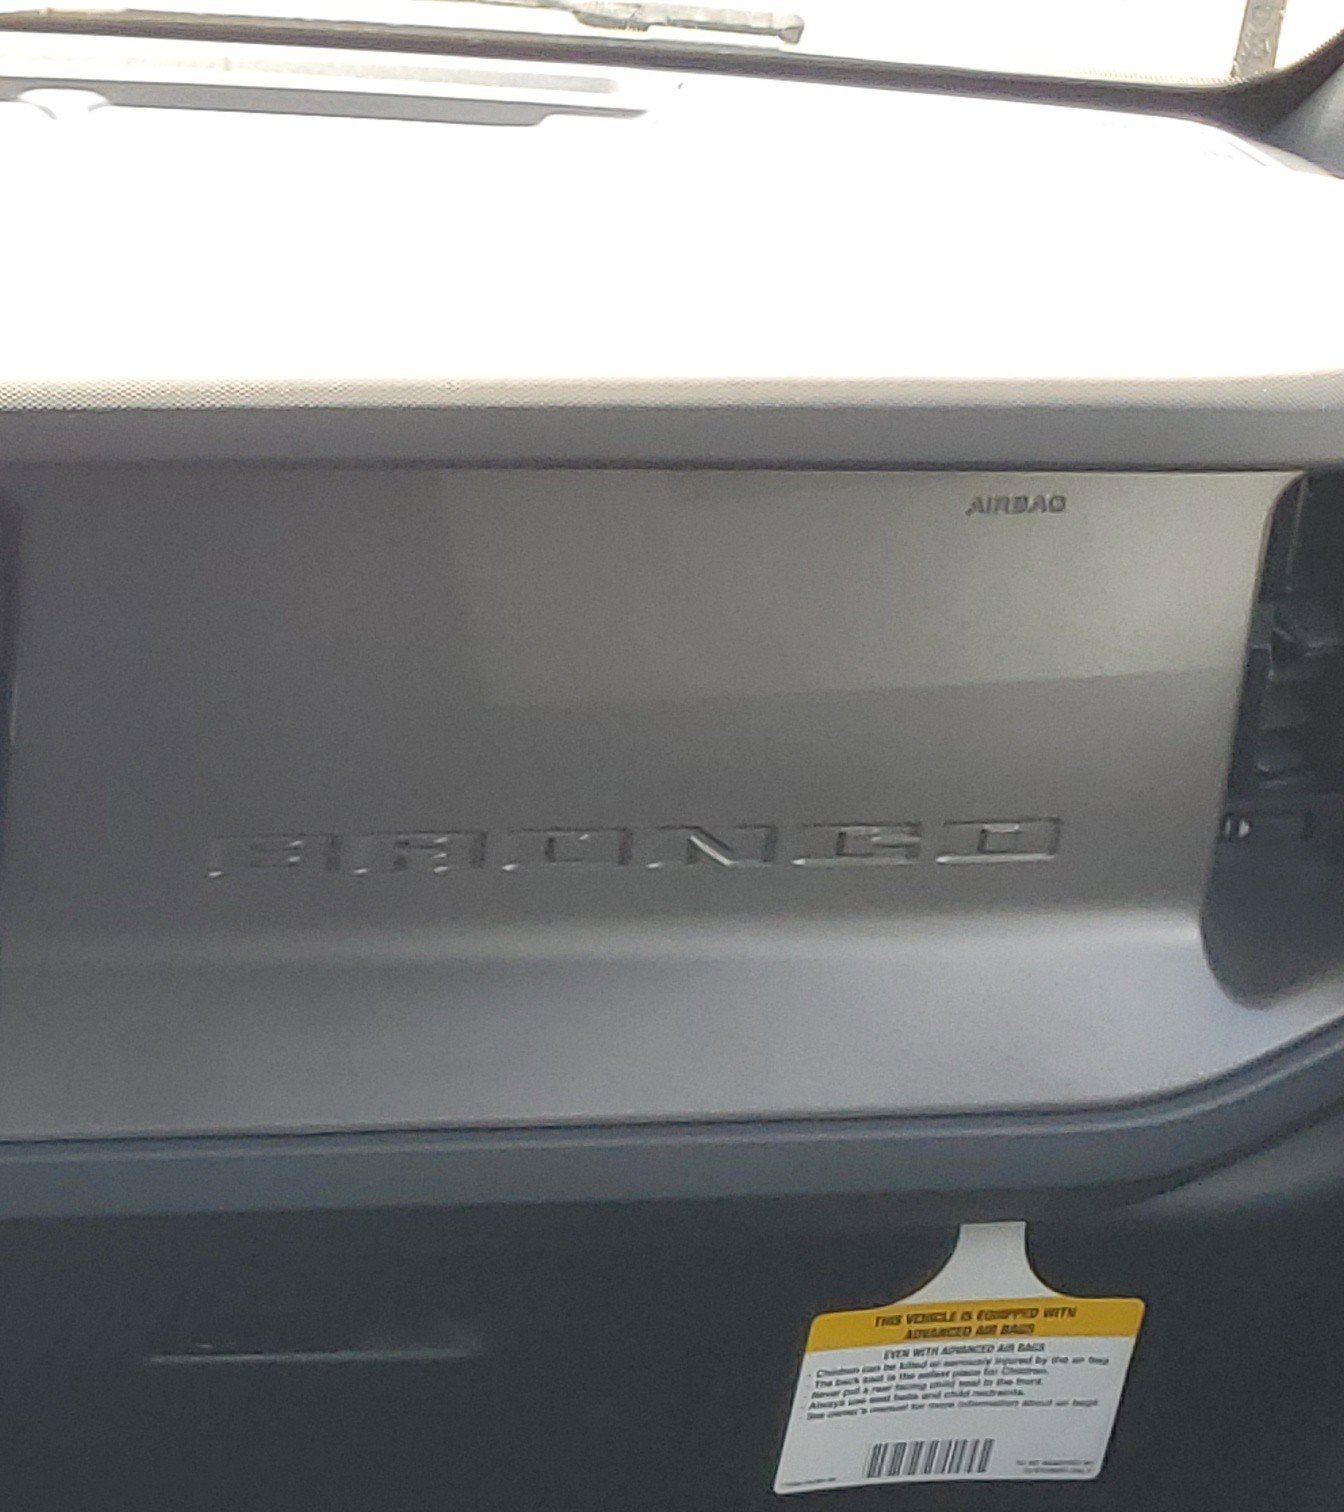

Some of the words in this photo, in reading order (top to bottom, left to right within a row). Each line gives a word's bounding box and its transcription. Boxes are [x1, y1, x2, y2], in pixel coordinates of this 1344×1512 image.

[965, 495, 1066, 516] AIRBAG
[204, 817, 1063, 876] BRONCO
[906, 1311, 958, 1325] VEHICLE
[977, 1308, 1039, 1321] EQUIPPED
[1043, 1307, 1077, 1318] WITH
[905, 1326, 972, 1340] ADVANCED
